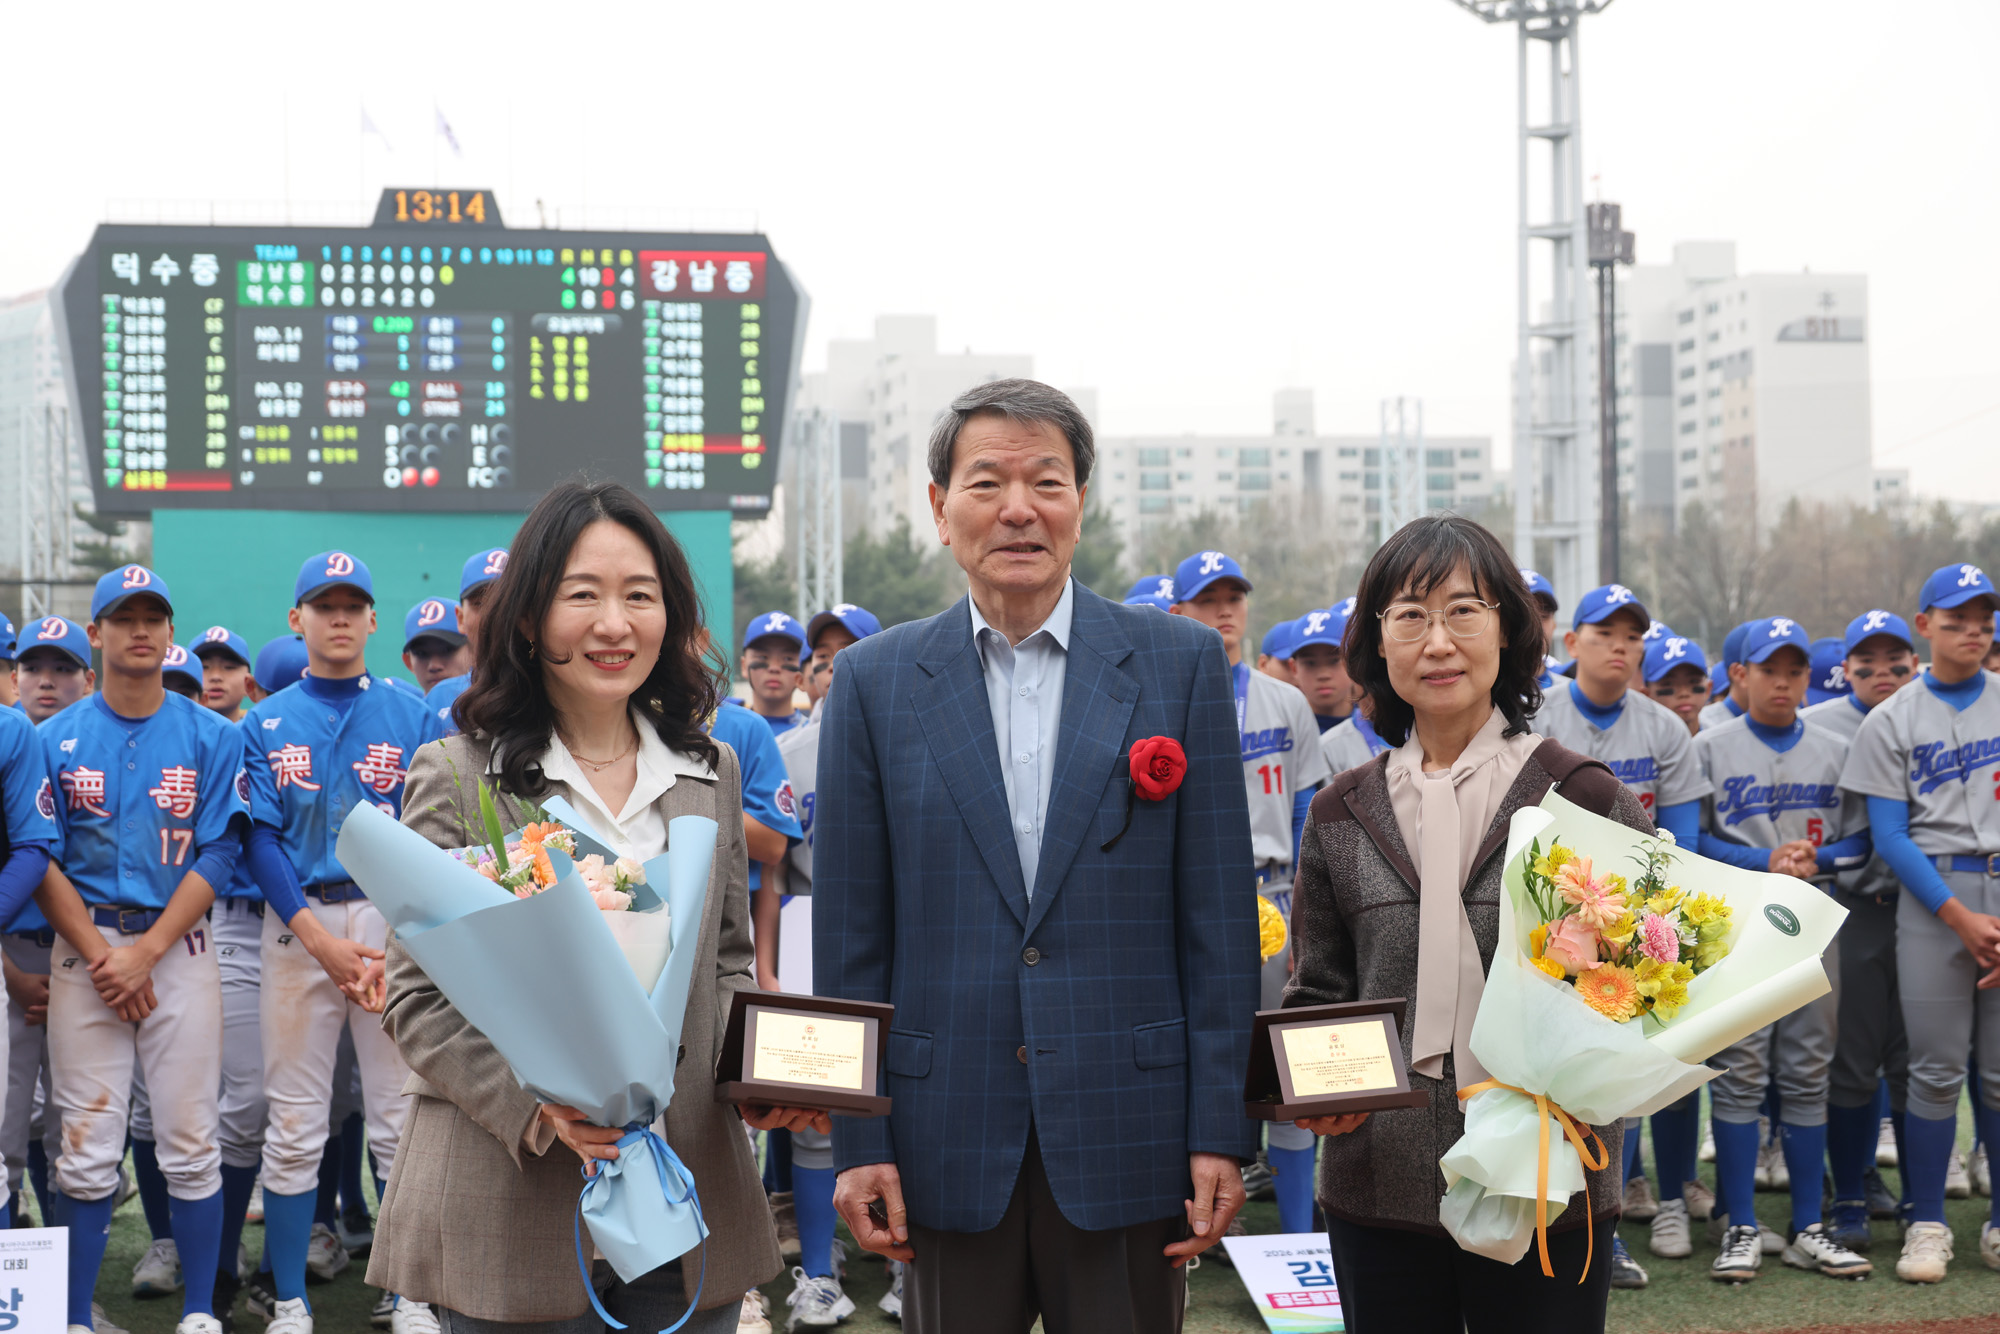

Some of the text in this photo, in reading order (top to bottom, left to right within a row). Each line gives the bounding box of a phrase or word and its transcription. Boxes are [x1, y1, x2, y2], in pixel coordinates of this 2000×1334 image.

[395, 190, 486, 221] 13:14
[255, 245, 297, 261] TEAM
[322, 246, 331, 261] 1
[381, 247, 392, 262] 4
[442, 247, 452, 262] 7
[496, 249, 514, 264] 10
[516, 249, 532, 264] 11
[112, 253, 219, 286] 덕수중
[321, 264, 335, 283] 0
[342, 264, 354, 283] 2
[361, 265, 374, 283] 2
[381, 265, 394, 284] 0
[400, 265, 414, 284] 0
[420, 265, 434, 284] 0
[440, 266, 454, 284] 0
[561, 267, 575, 285] 4
[579, 268, 600, 286] 10
[620, 268, 634, 286] 4
[651, 260, 753, 292] 강남중
[321, 287, 335, 306] 0
[341, 287, 355, 306] 0
[362, 287, 375, 306] 2
[381, 288, 394, 306] 4
[401, 288, 414, 307] 2
[420, 288, 434, 307] 0
[561, 289, 576, 309] 8
[255, 327, 281, 342] NO.
[492, 318, 504, 333] 0
[210, 337, 221, 352] C
[492, 336, 504, 352] 0
[492, 355, 505, 370] 0
[745, 360, 757, 375] C
[255, 382, 281, 397] NO.
[426, 383, 456, 398] BALL
[398, 400, 410, 416] 0
[423, 401, 460, 416] STRIKE
[386, 425, 399, 445] B
[471, 425, 487, 443] H
[386, 445, 398, 466] S
[473, 446, 486, 466] E
[384, 465, 401, 487] O
[468, 467, 495, 487] FC
[325, 552, 355, 577] D
[122, 565, 151, 590] D
[418, 600, 446, 627] D
[37, 616, 69, 641] D
[1258, 765, 1283, 795] 11
[1717, 774, 1840, 826] Kangnam
[1807, 818, 1823, 846] 5
[160, 828, 193, 866] 17
[1769, 909, 1794, 932] DOMINICA
[184, 929, 206, 956] 17
[1263, 1249, 1294, 1257] 2026
[3, 1258, 28, 1271] 대회
[1287, 1260, 1336, 1288] 감
